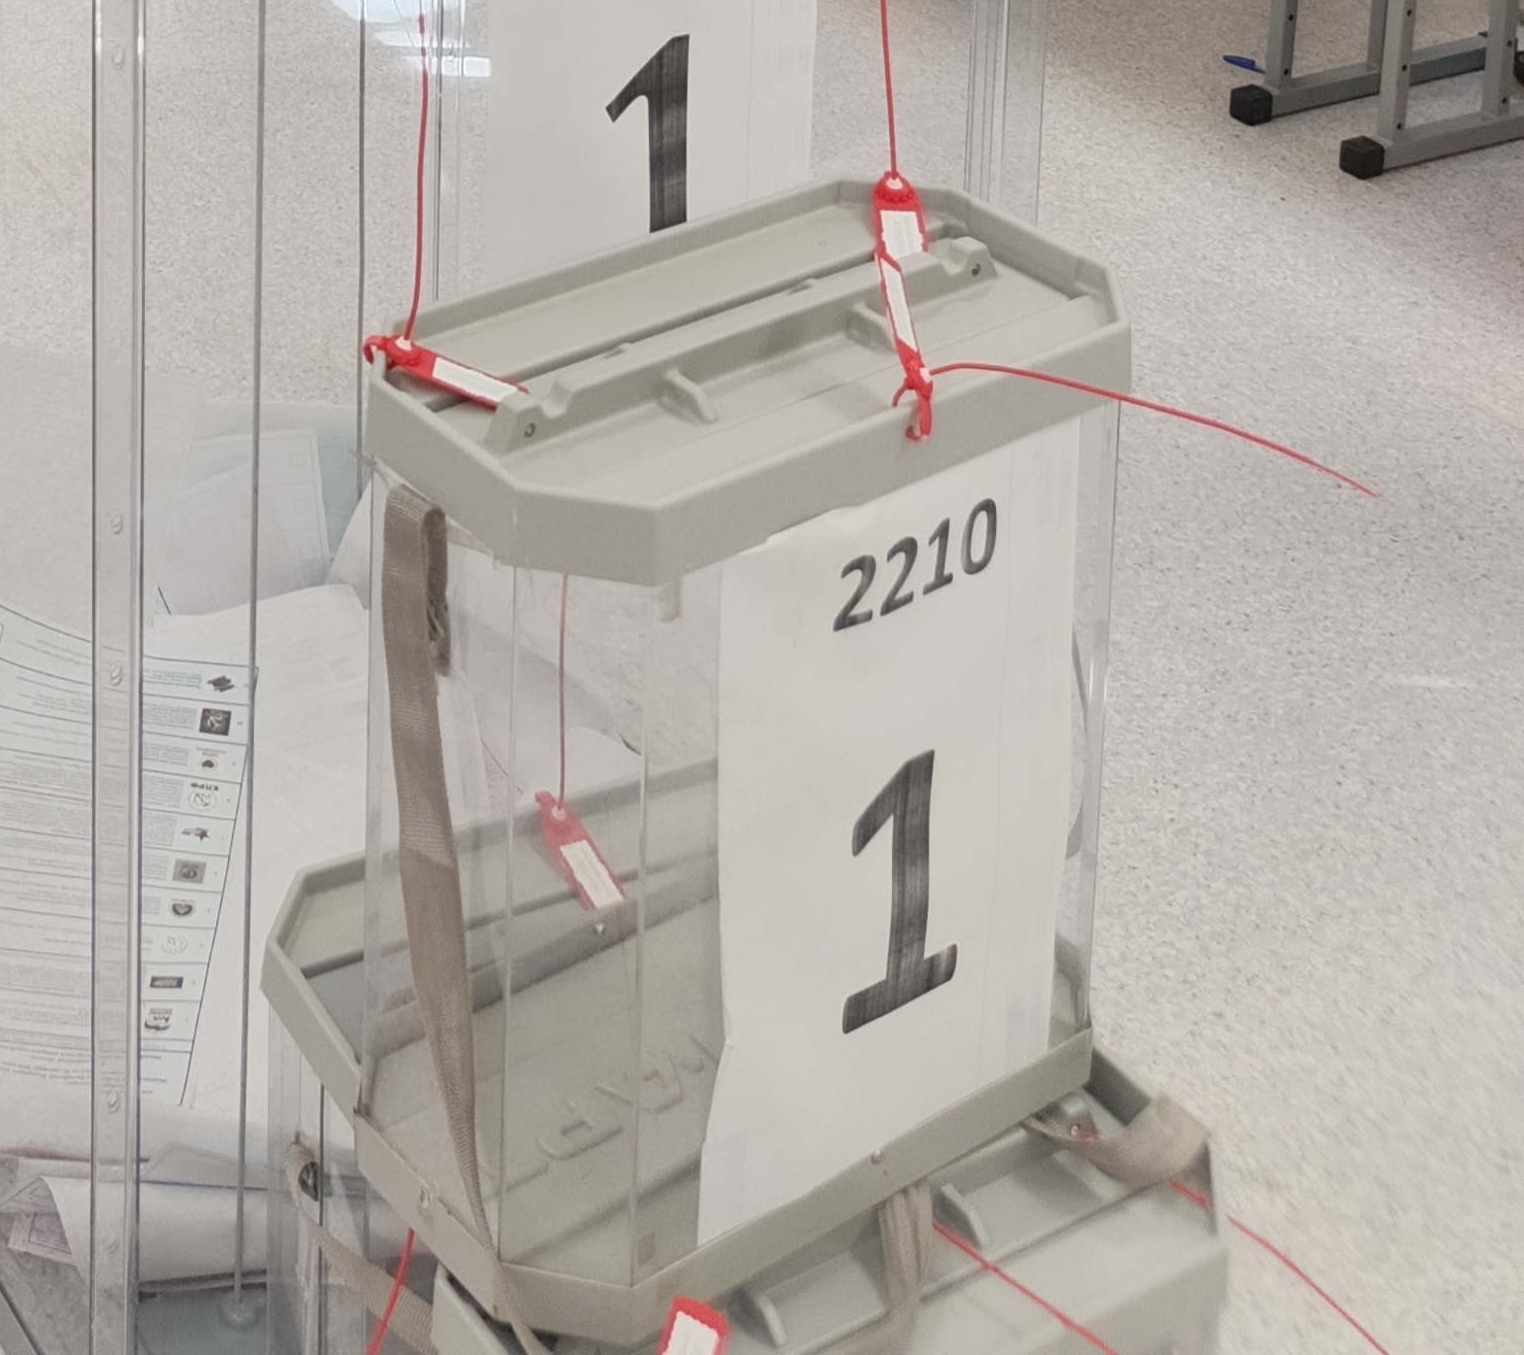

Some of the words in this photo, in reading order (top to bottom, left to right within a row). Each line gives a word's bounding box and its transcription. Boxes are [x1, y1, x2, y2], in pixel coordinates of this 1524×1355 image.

[605, 33, 690, 234] 1
[833, 498, 998, 632] 2210
[842, 748, 958, 1035] 1
